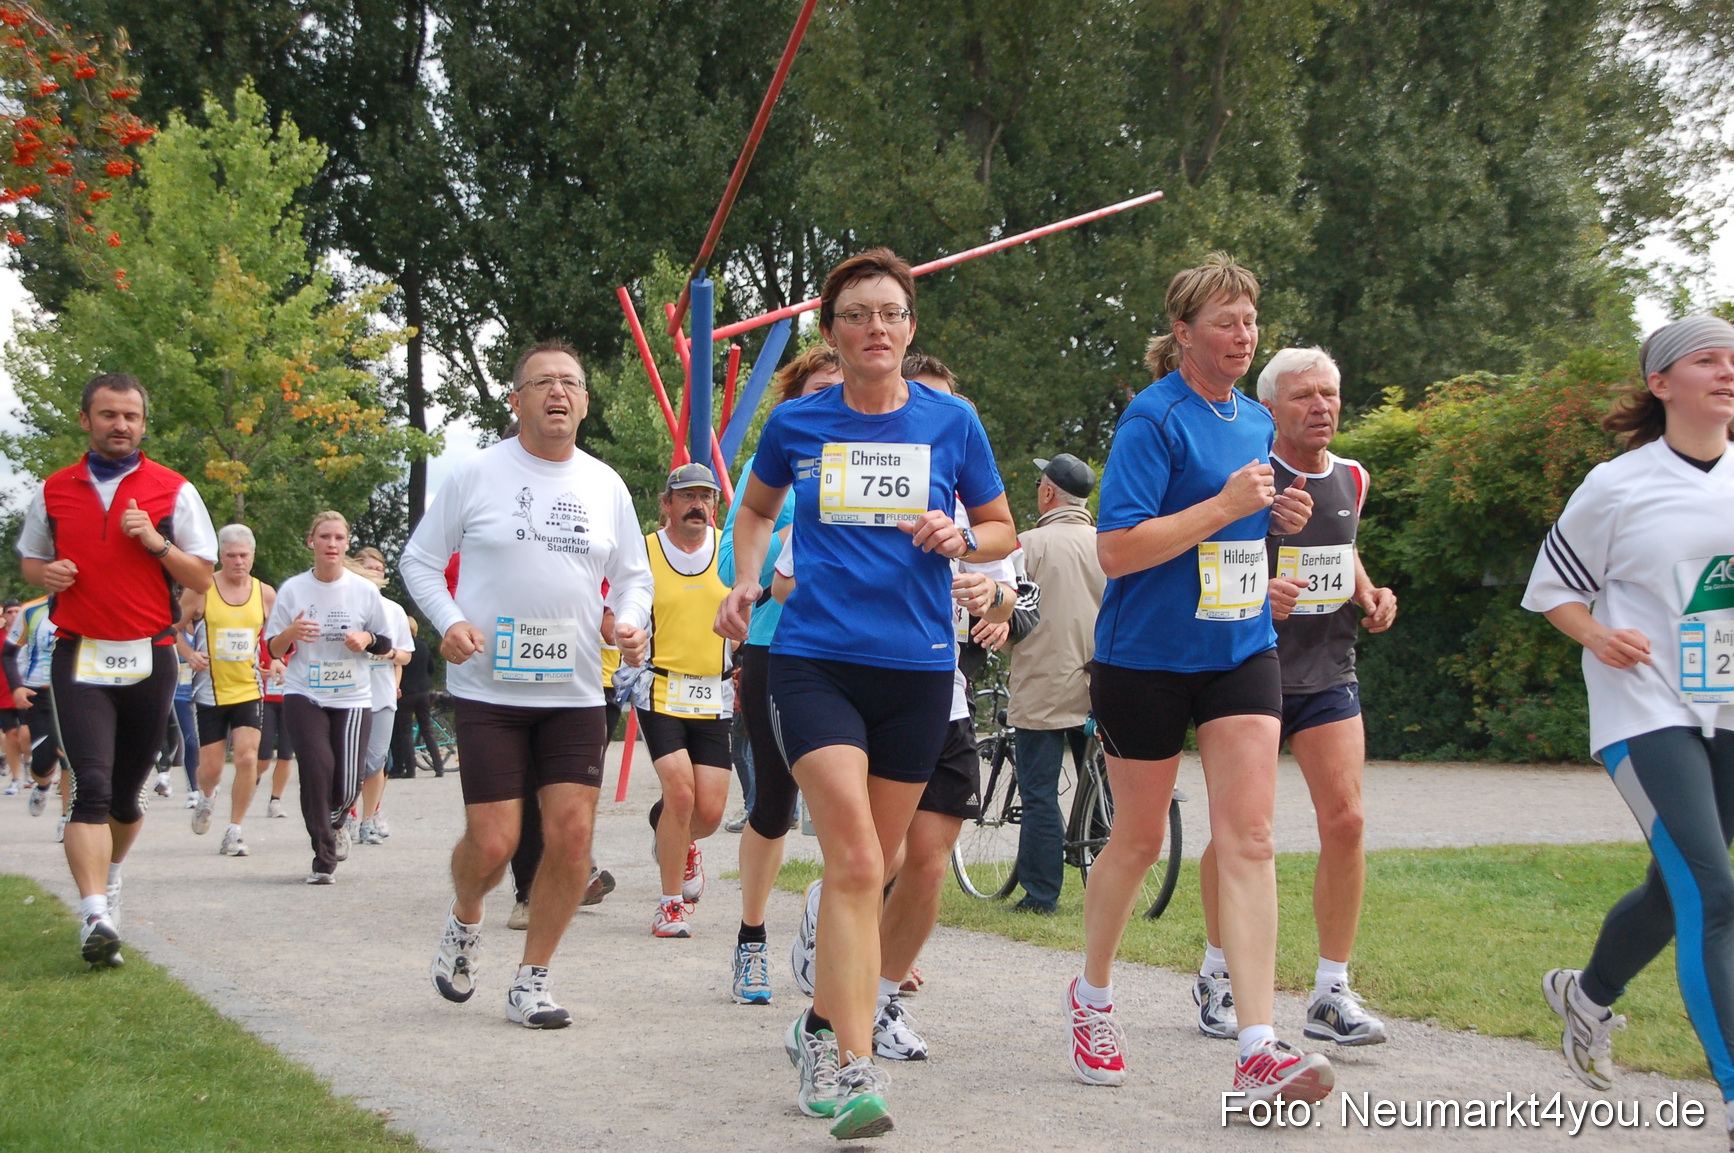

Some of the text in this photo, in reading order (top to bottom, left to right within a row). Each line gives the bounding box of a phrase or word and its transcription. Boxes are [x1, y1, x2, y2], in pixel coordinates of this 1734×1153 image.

[851, 450, 901, 467] Christa
[861, 475, 911, 498] 756
[516, 528, 590, 547] 9. Neumarkter
[547, 542, 590, 555] Stadtlauf
[1301, 552, 1342, 567] Gerhard
[1239, 572, 1257, 595] 11
[1307, 572, 1343, 592] 314
[520, 623, 548, 636] Peter
[231, 641, 249, 651] 760
[519, 642, 568, 660] 2648
[105, 656, 138, 669] 981
[1689, 652, 1696, 664] C
[1715, 653, 1734, 675] 2
[323, 669, 353, 682] 2244
[688, 685, 712, 700] 753
